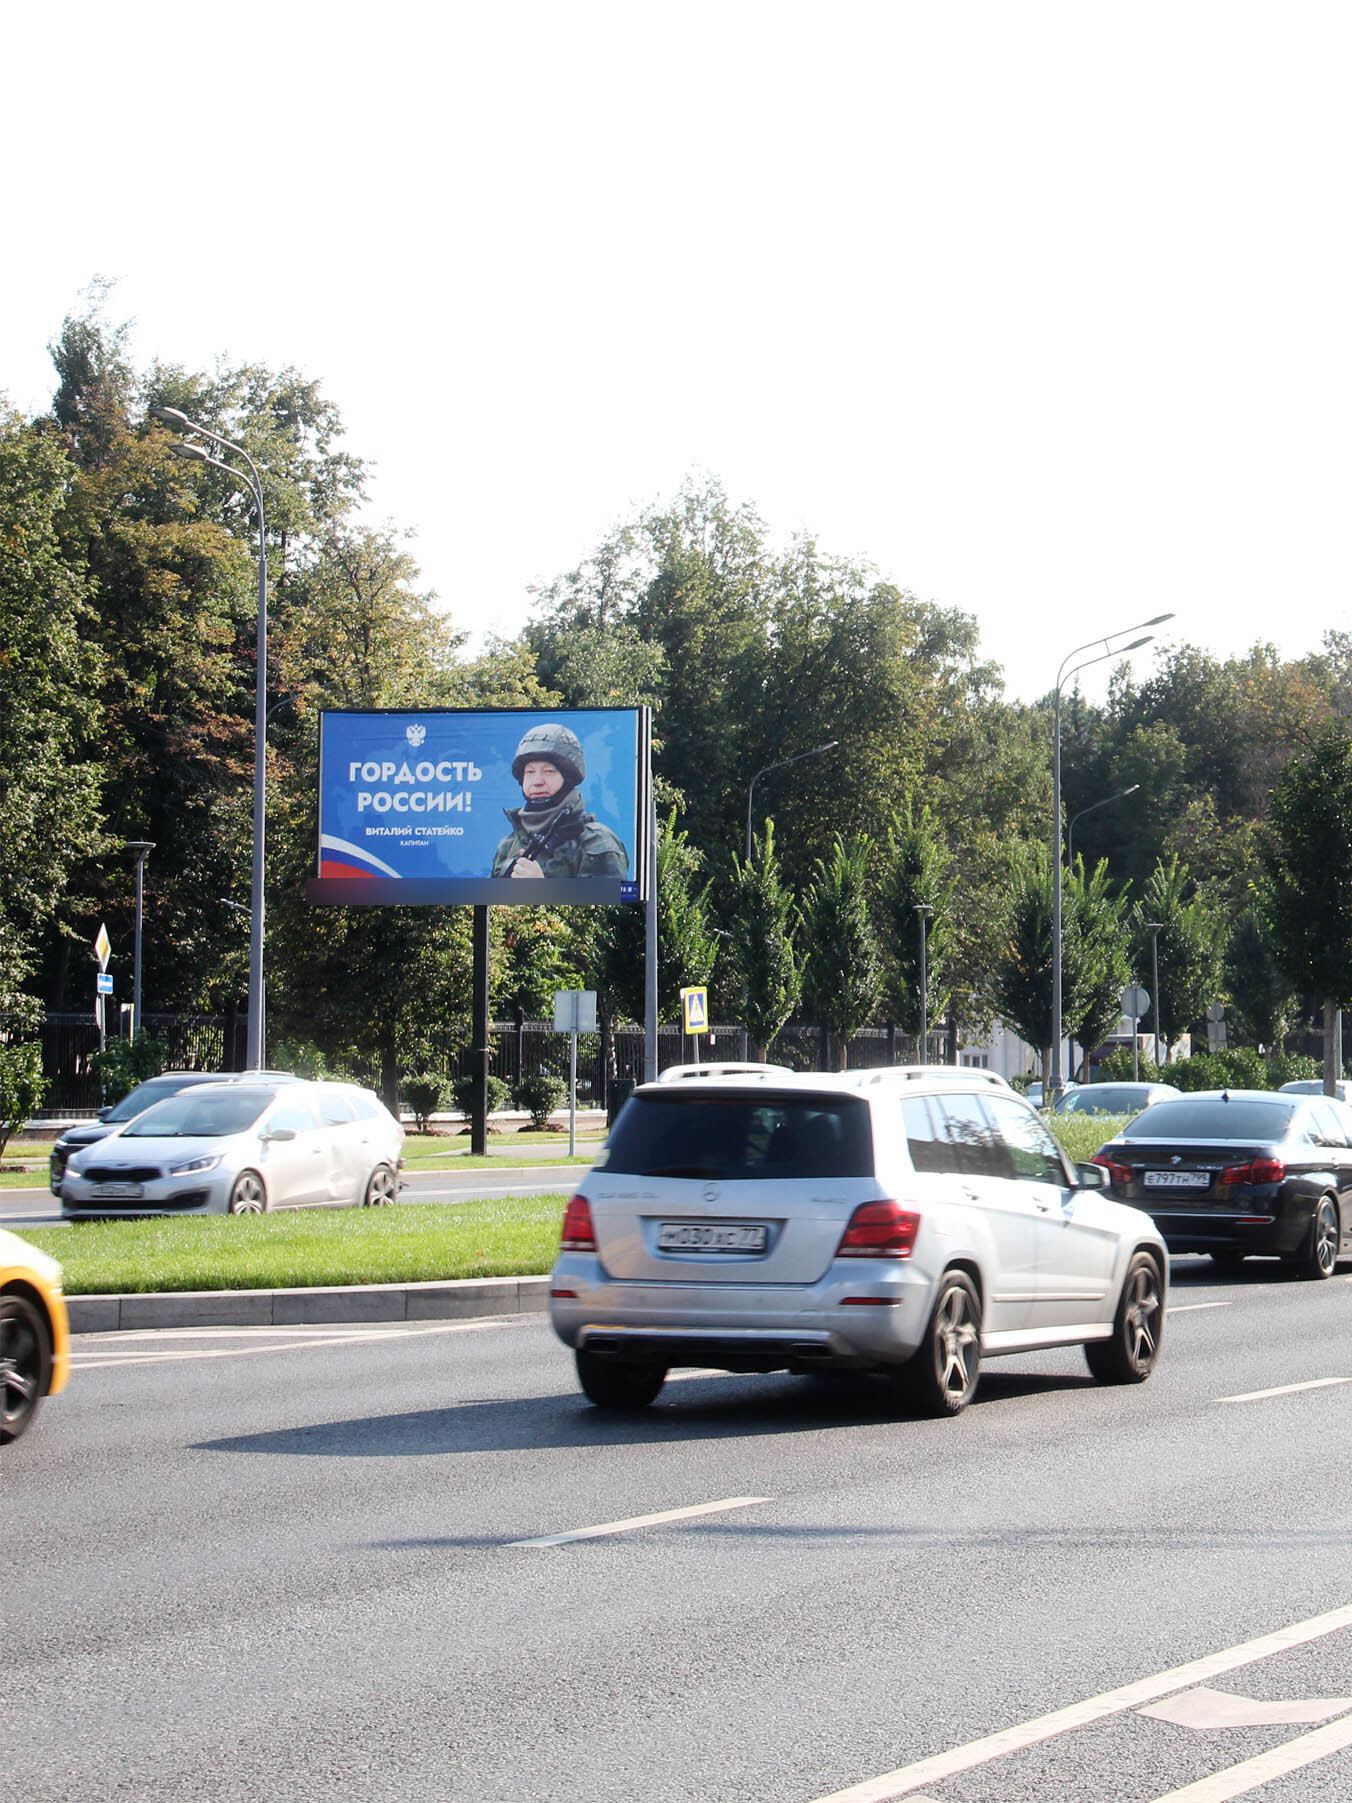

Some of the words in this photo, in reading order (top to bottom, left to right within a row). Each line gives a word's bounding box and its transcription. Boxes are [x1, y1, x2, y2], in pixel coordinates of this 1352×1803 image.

[349, 761, 482, 785] ГОРДОСТЬ
[357, 791, 472, 813] РОССИИ!
[365, 825, 412, 836] ВИТАЛИЙ
[415, 825, 464, 836] СТАТЕЙКО
[400, 839, 429, 847] КАПИТАН
